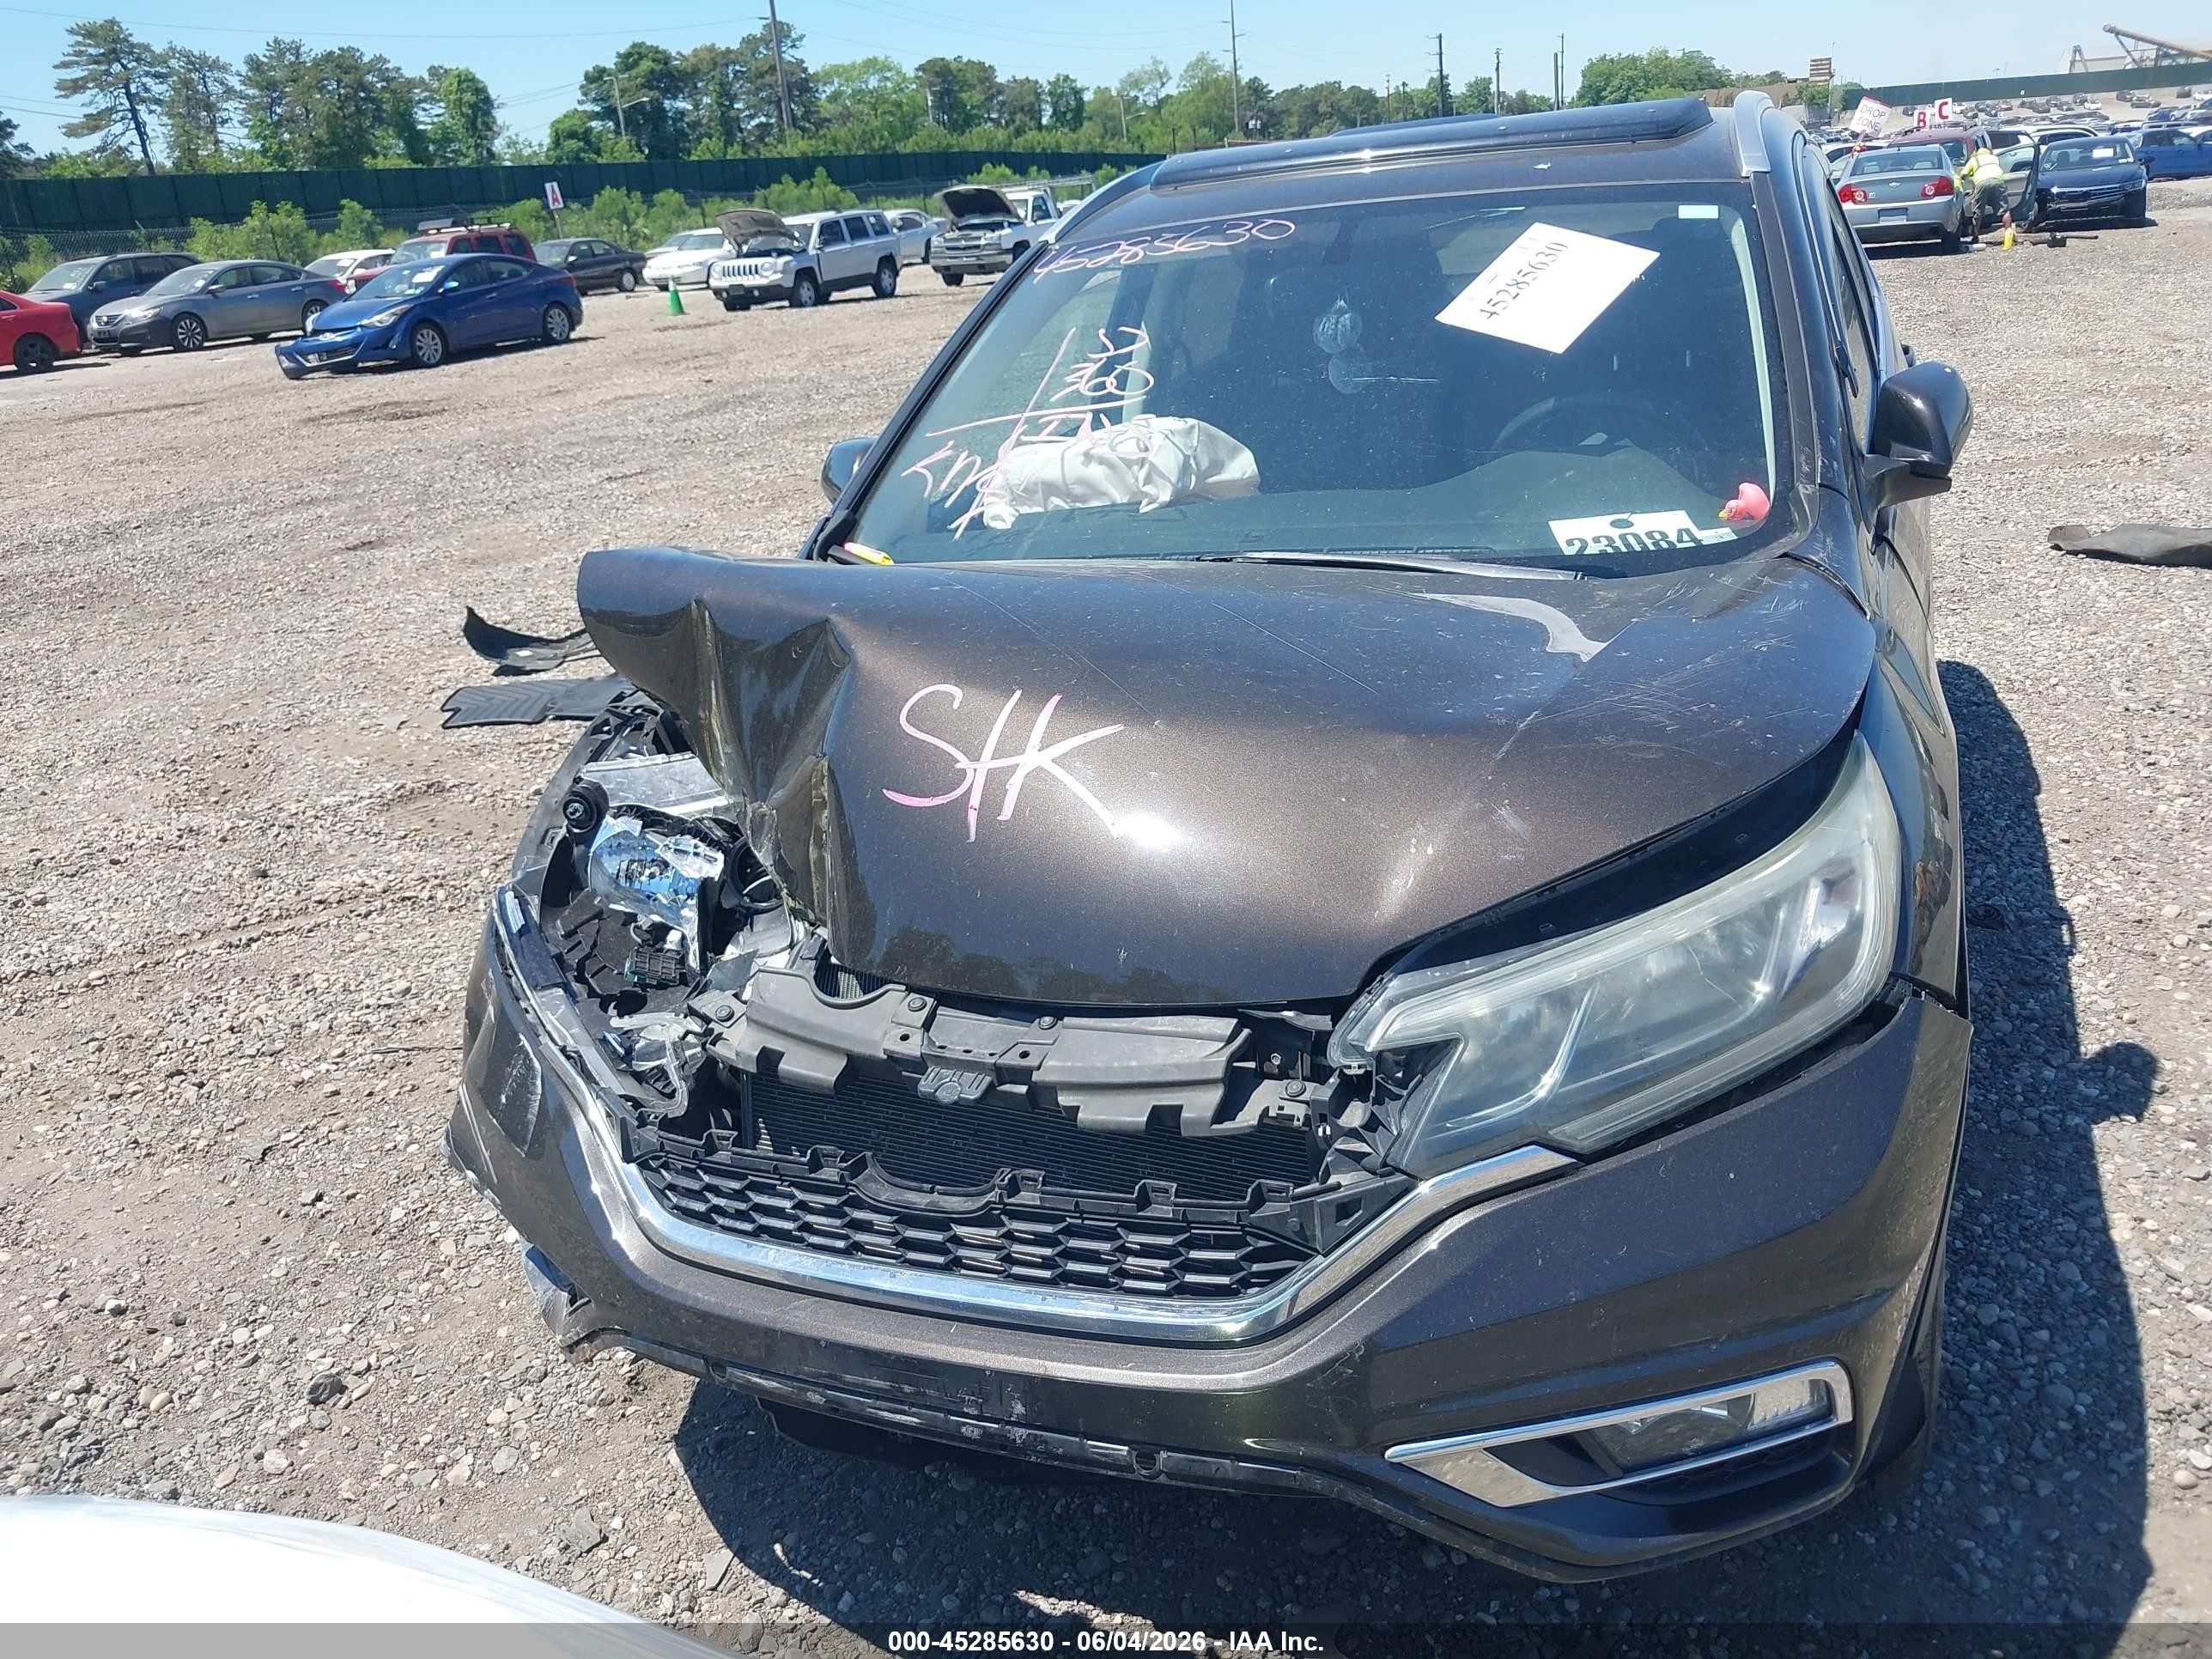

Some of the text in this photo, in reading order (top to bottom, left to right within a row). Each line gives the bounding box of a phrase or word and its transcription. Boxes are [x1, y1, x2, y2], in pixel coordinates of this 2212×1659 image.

[1860, 104, 1887, 118] DROP
[1917, 111, 1927, 128] B
[1938, 101, 1948, 119] C
[1856, 117, 1881, 131] ZONE
[550, 183, 561, 206] A
[1032, 218, 1296, 284] 45285630
[1479, 241, 1569, 319] 45285630
[1565, 527, 1704, 555] 23084
